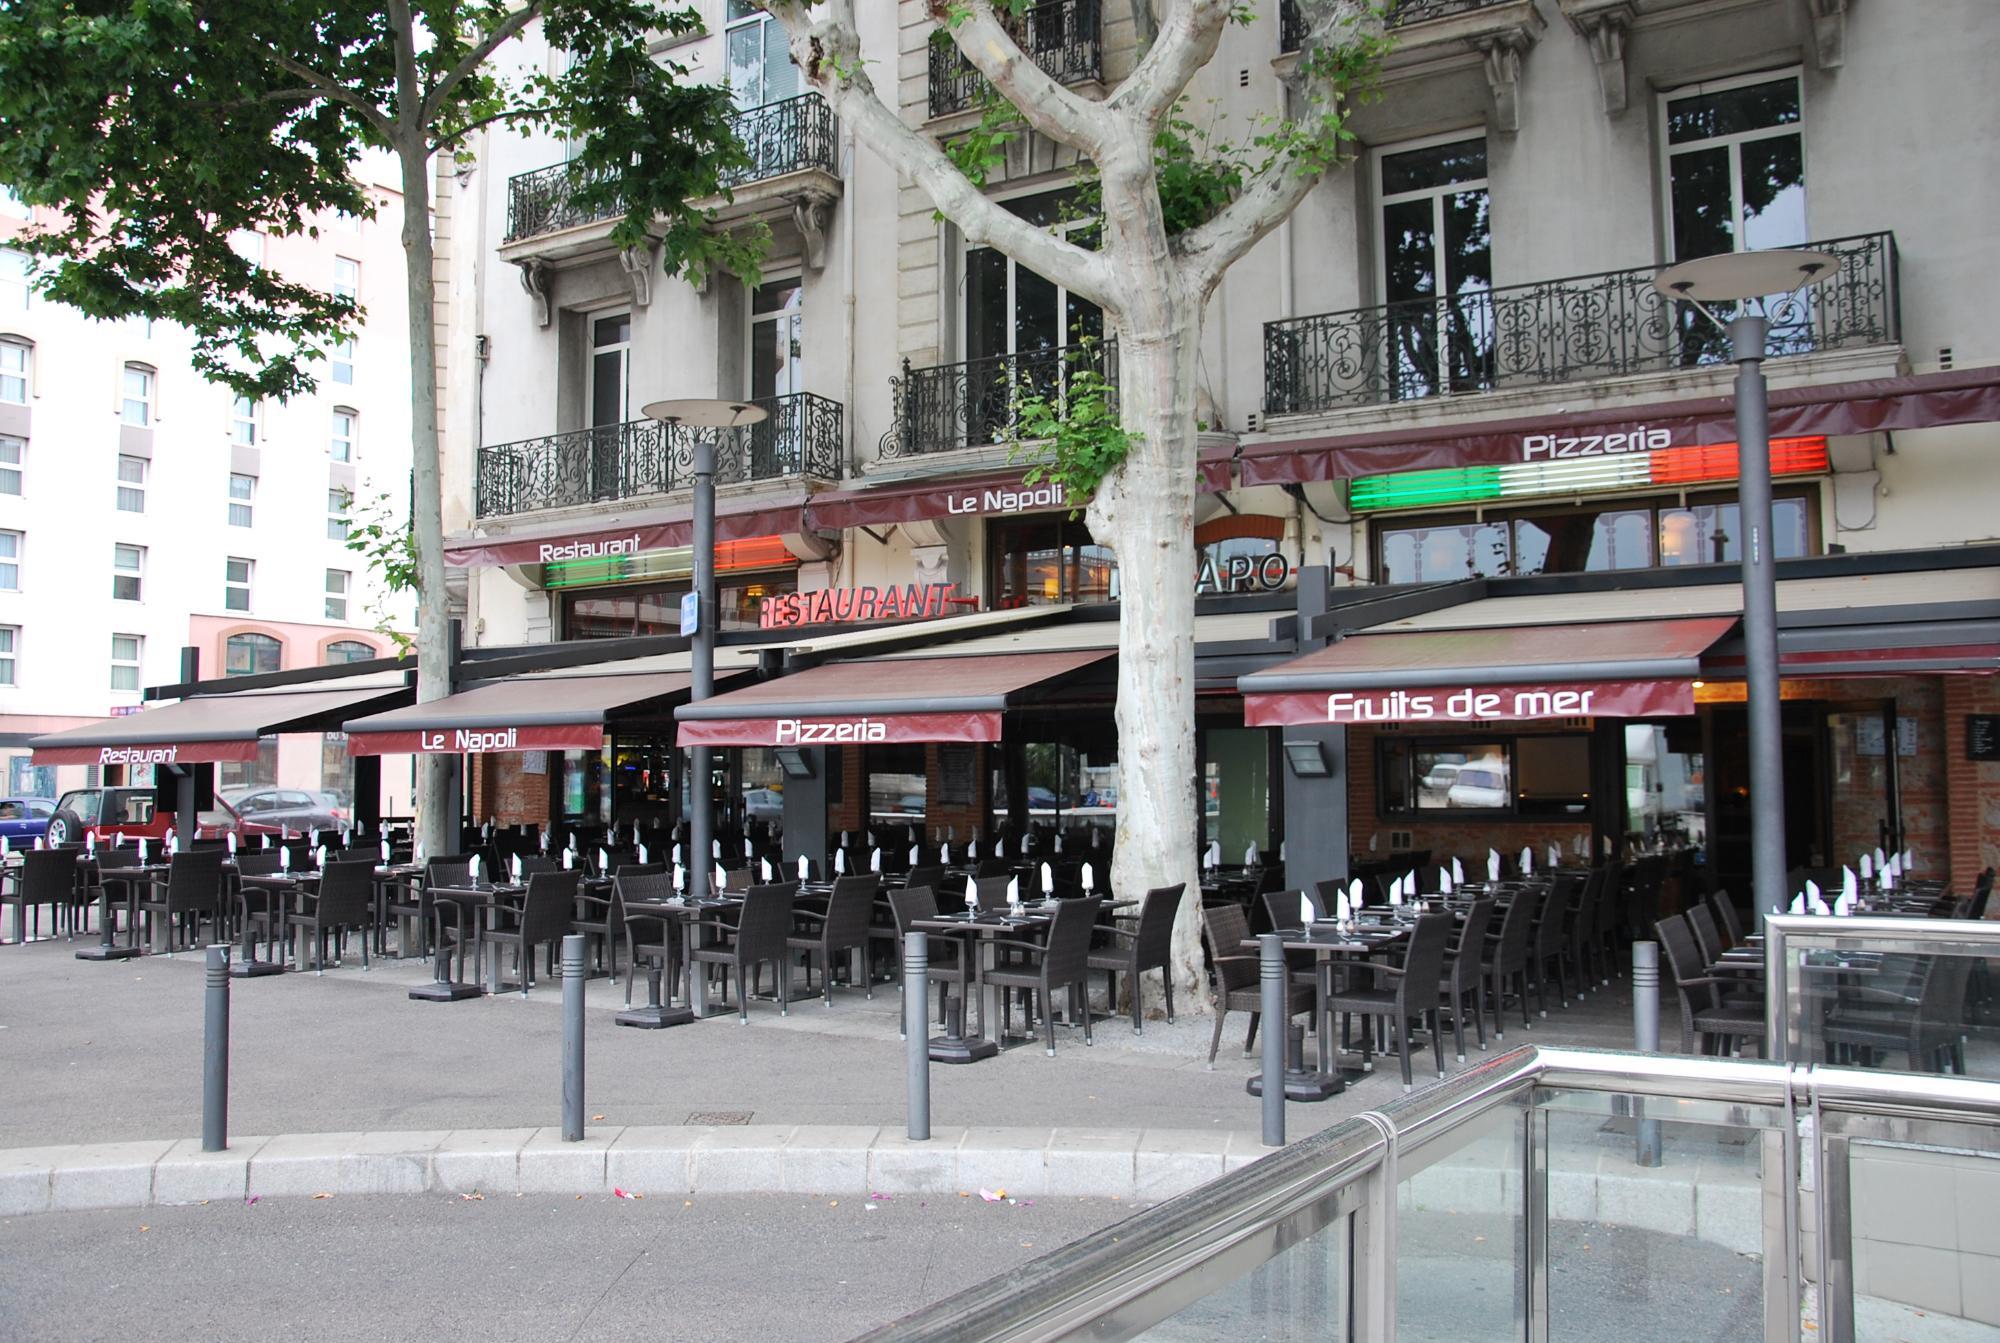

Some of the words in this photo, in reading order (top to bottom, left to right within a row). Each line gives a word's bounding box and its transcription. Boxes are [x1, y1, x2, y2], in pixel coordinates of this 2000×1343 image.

[1523, 425, 1671, 461] Pizzeria
[947, 490, 977, 514] Le
[984, 484, 1062, 512] Napoli
[539, 533, 640, 563] Restaurant
[758, 582, 954, 628] RESTAURANT
[1328, 691, 1433, 721] Fruits
[1446, 688, 1500, 718] de
[1514, 690, 1594, 716] mer
[421, 731, 444, 750] Le
[455, 728, 517, 752] Napoli
[776, 718, 886, 743] Pizzeria
[99, 745, 177, 763] Restaurant
